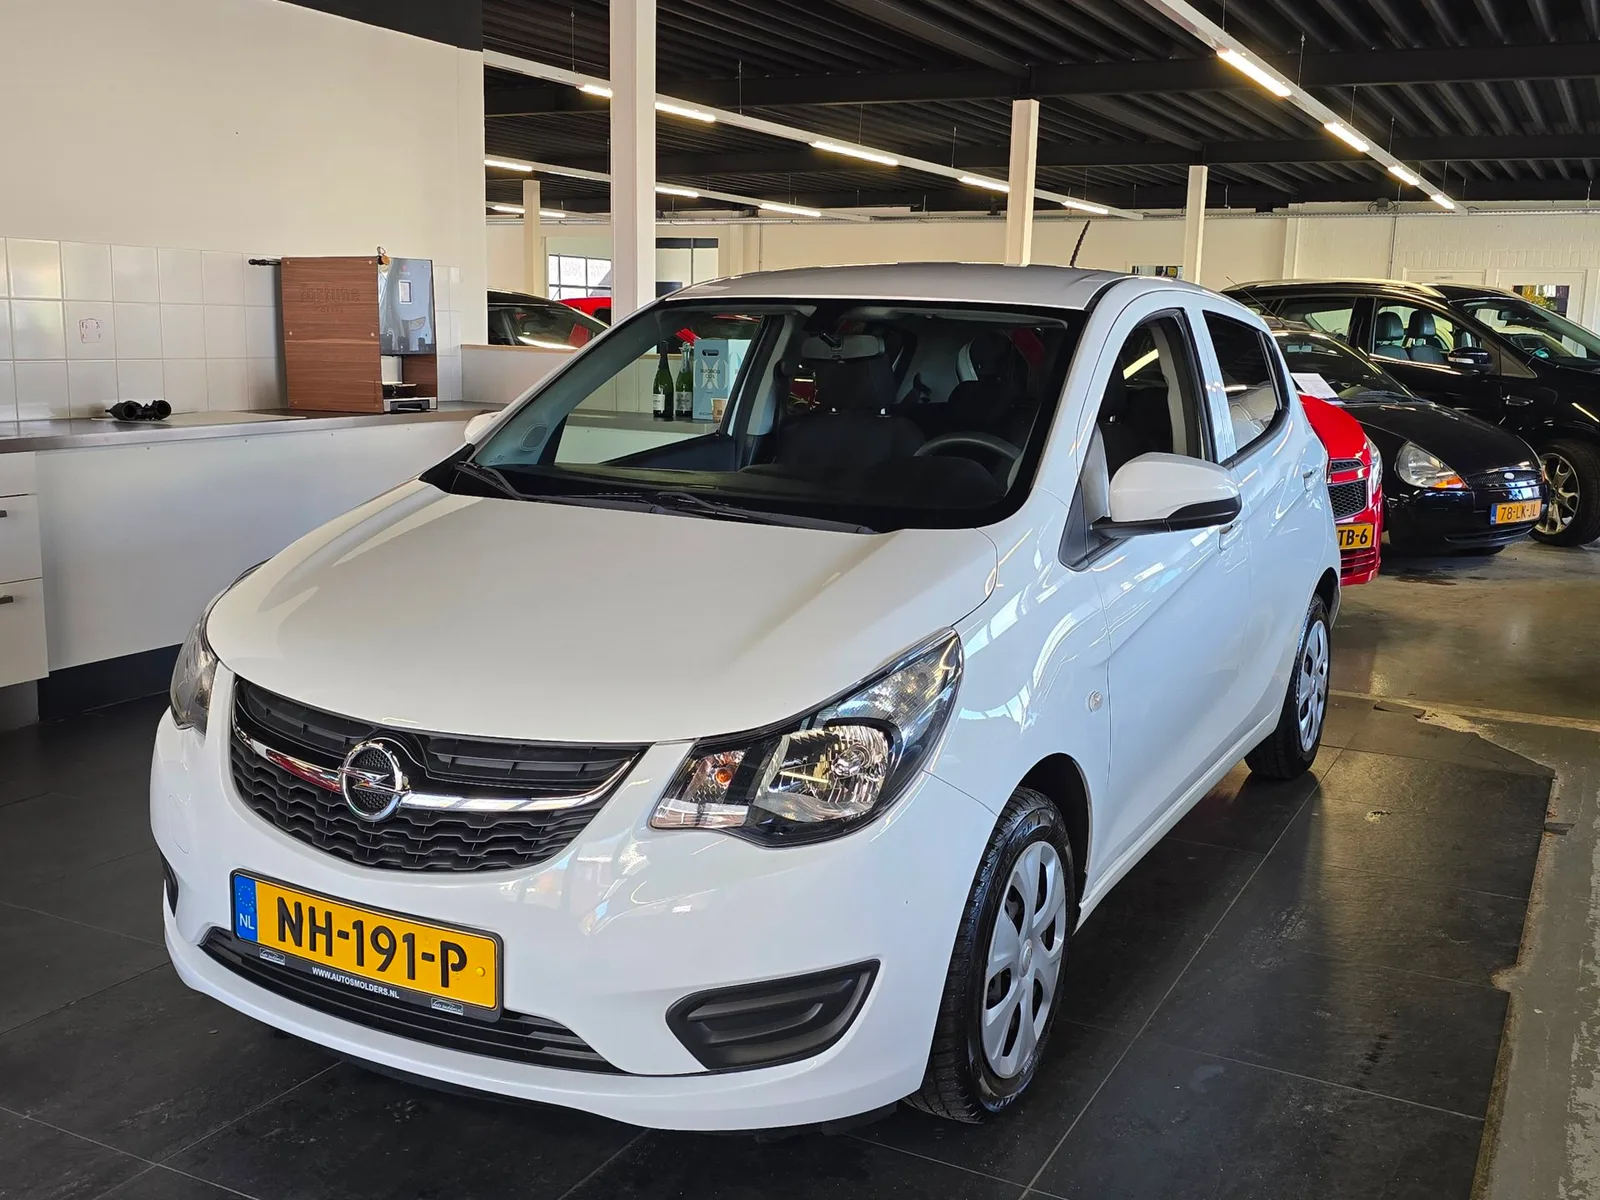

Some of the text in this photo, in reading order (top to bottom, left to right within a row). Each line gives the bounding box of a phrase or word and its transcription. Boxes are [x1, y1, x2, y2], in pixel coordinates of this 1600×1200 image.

[1500, 504, 1537, 520] 78-LK-JL
[239, 912, 255, 930] NL
[276, 896, 468, 988] NH-191-P
[311, 967, 400, 999] WWW.AUTOSMOLDERS.NL
